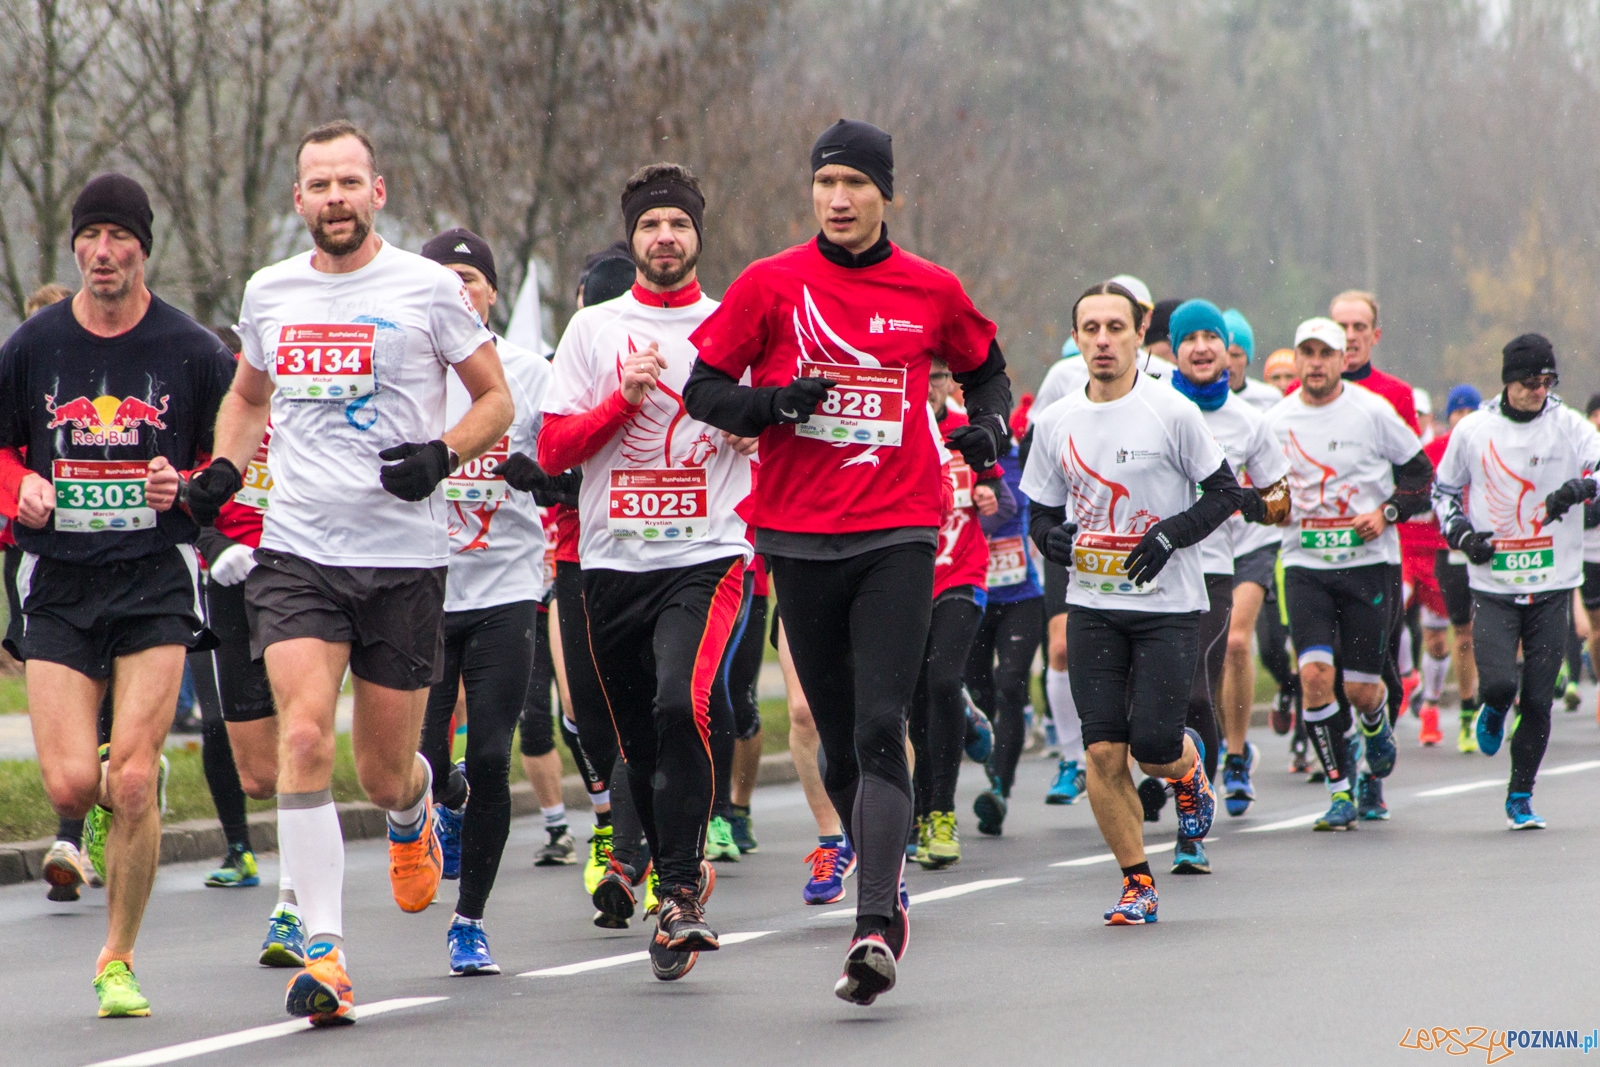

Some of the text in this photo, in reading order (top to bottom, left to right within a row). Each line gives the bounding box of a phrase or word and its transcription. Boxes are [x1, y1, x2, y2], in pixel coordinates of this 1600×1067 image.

[278, 356, 285, 364] B
[288, 348, 362, 372] 3134
[856, 375, 898, 384] RunPoland.org
[822, 390, 882, 418] 828
[72, 430, 139, 446] Red Bull
[68, 484, 143, 507] 3303
[612, 500, 619, 508] B
[622, 492, 698, 516] 3025
[1314, 532, 1352, 548] 334
[1506, 552, 1543, 570] 604
